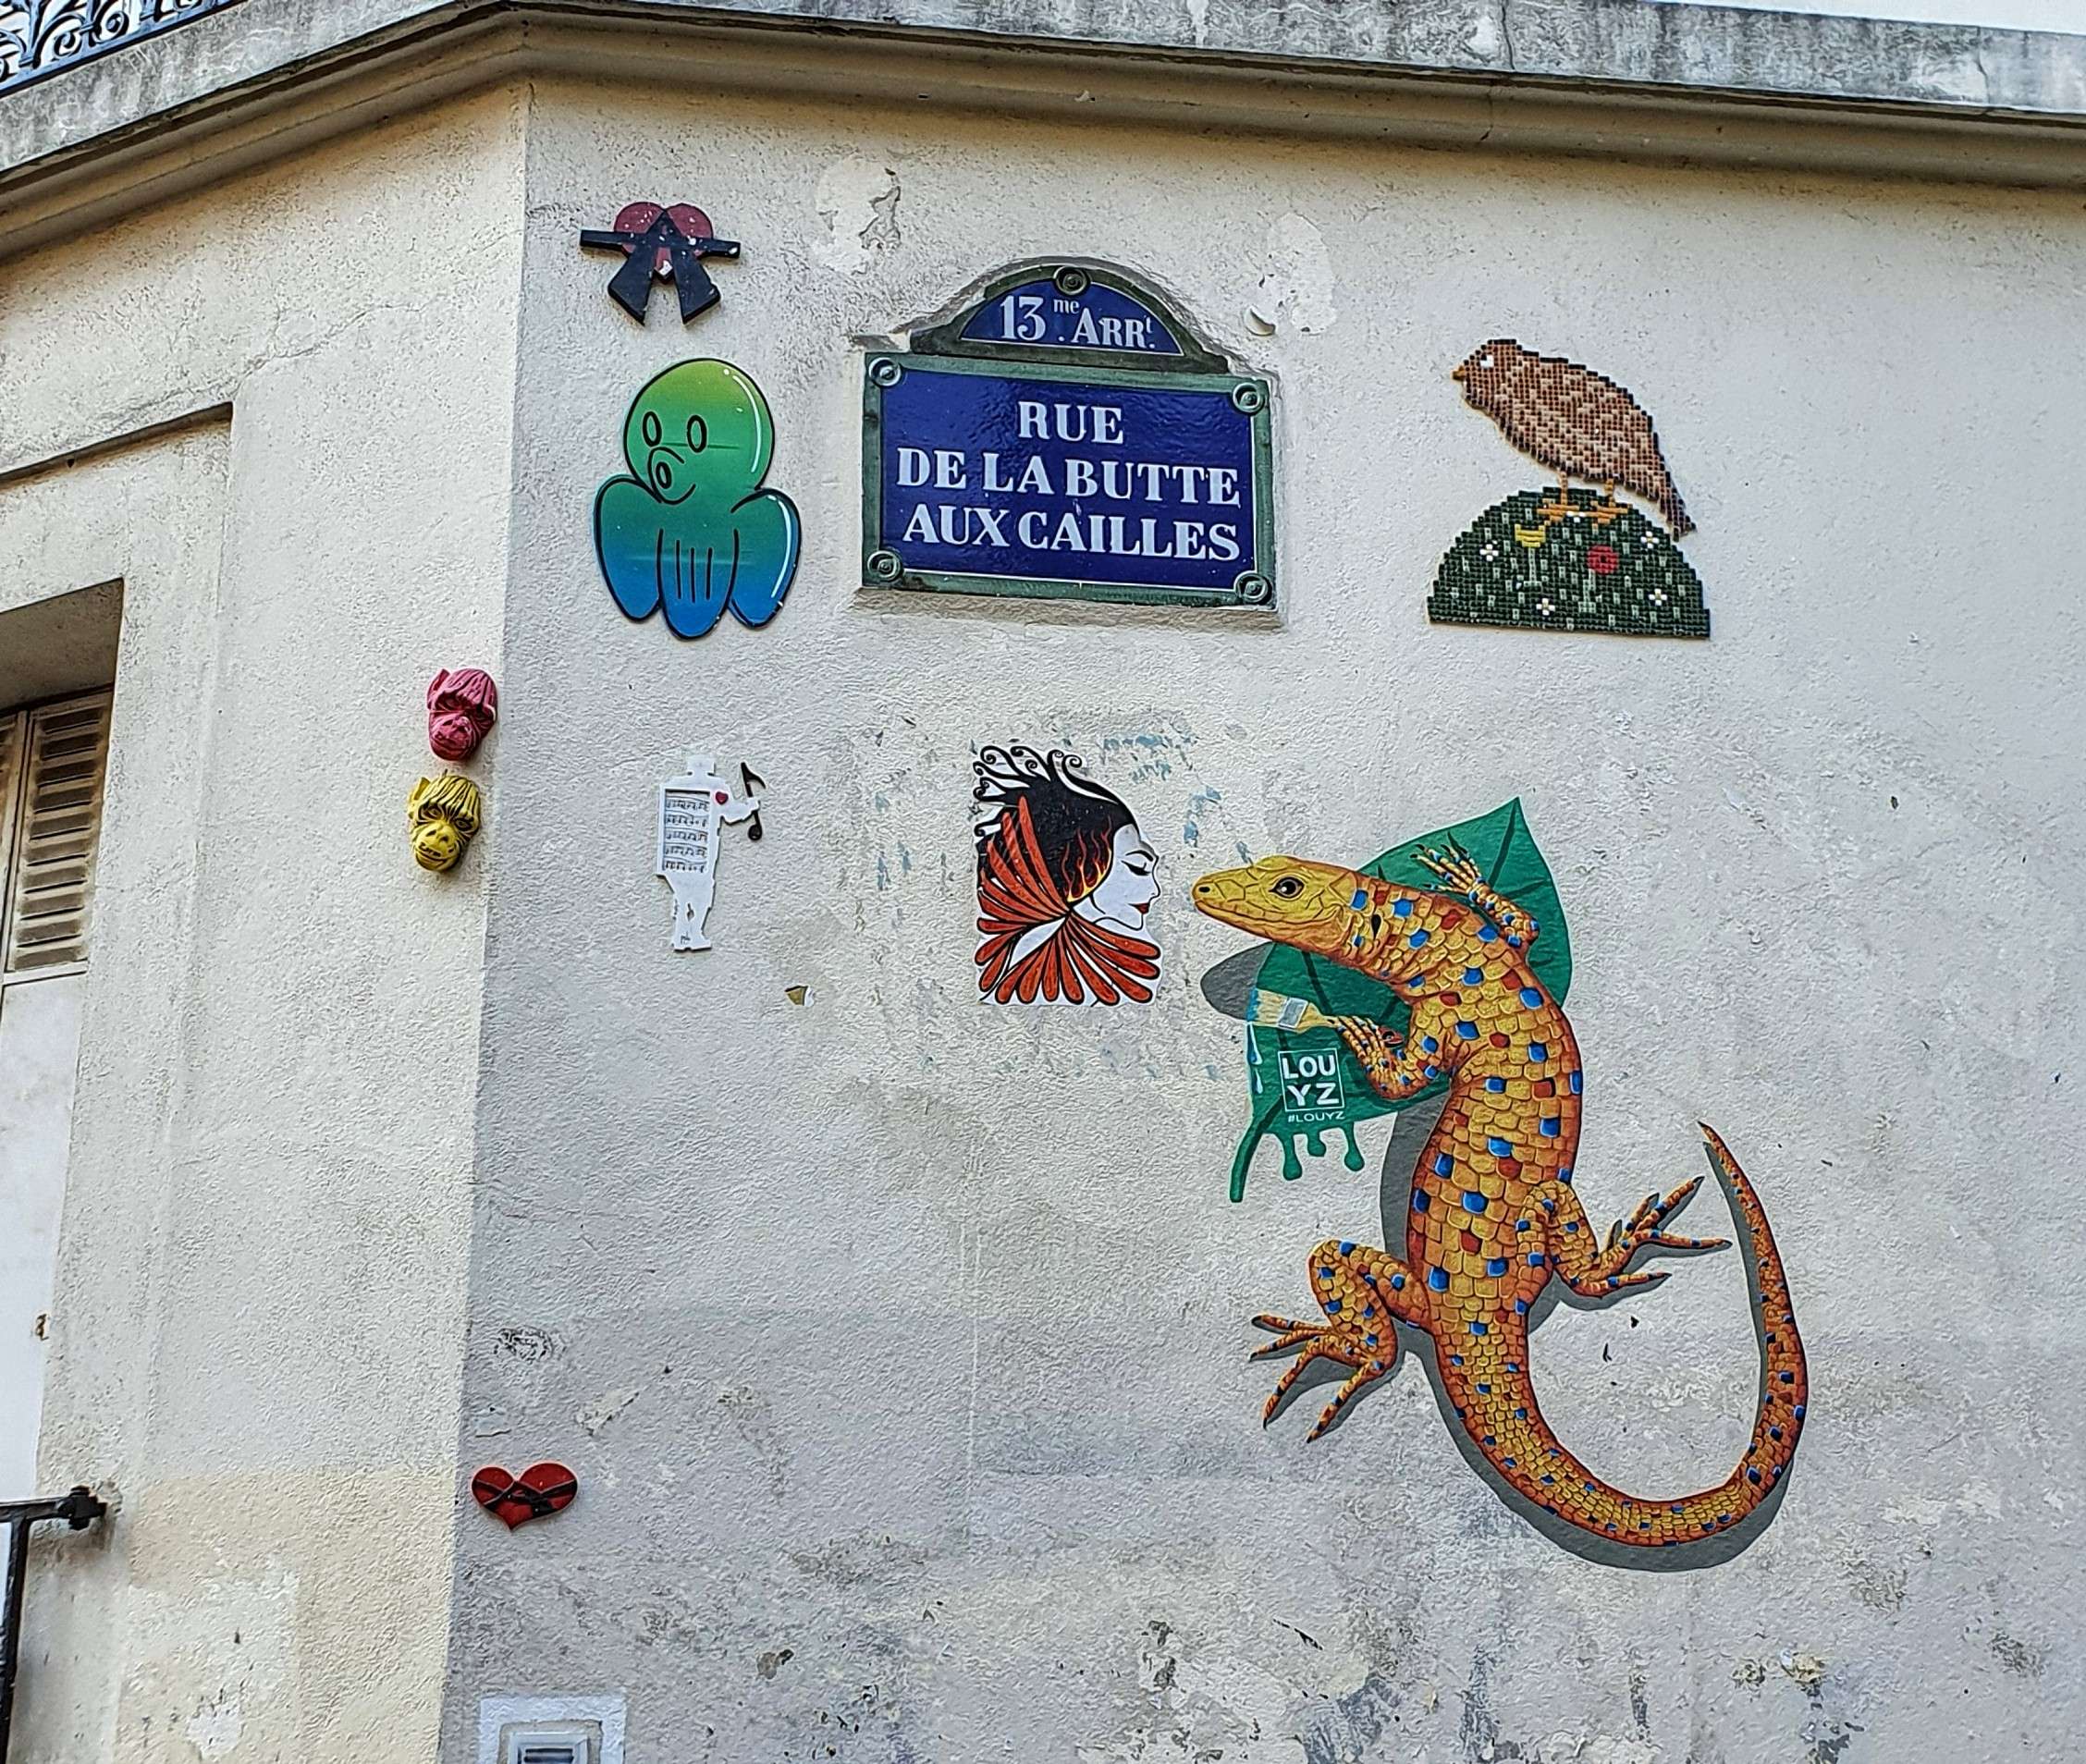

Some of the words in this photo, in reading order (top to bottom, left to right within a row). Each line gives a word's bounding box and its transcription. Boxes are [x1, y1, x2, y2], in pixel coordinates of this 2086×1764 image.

[1018, 401, 1123, 445] RUE
[896, 447, 967, 489] DE
[982, 452, 1055, 495] LA
[1064, 459, 1241, 506] BUTTE
[902, 504, 1011, 547] AUX
[1018, 511, 1240, 561] CAILLES
[1282, 1054, 1336, 1080] LOU
[1286, 1082, 1340, 1107] YZ
[1287, 1110, 1345, 1123] #LOUYZ
